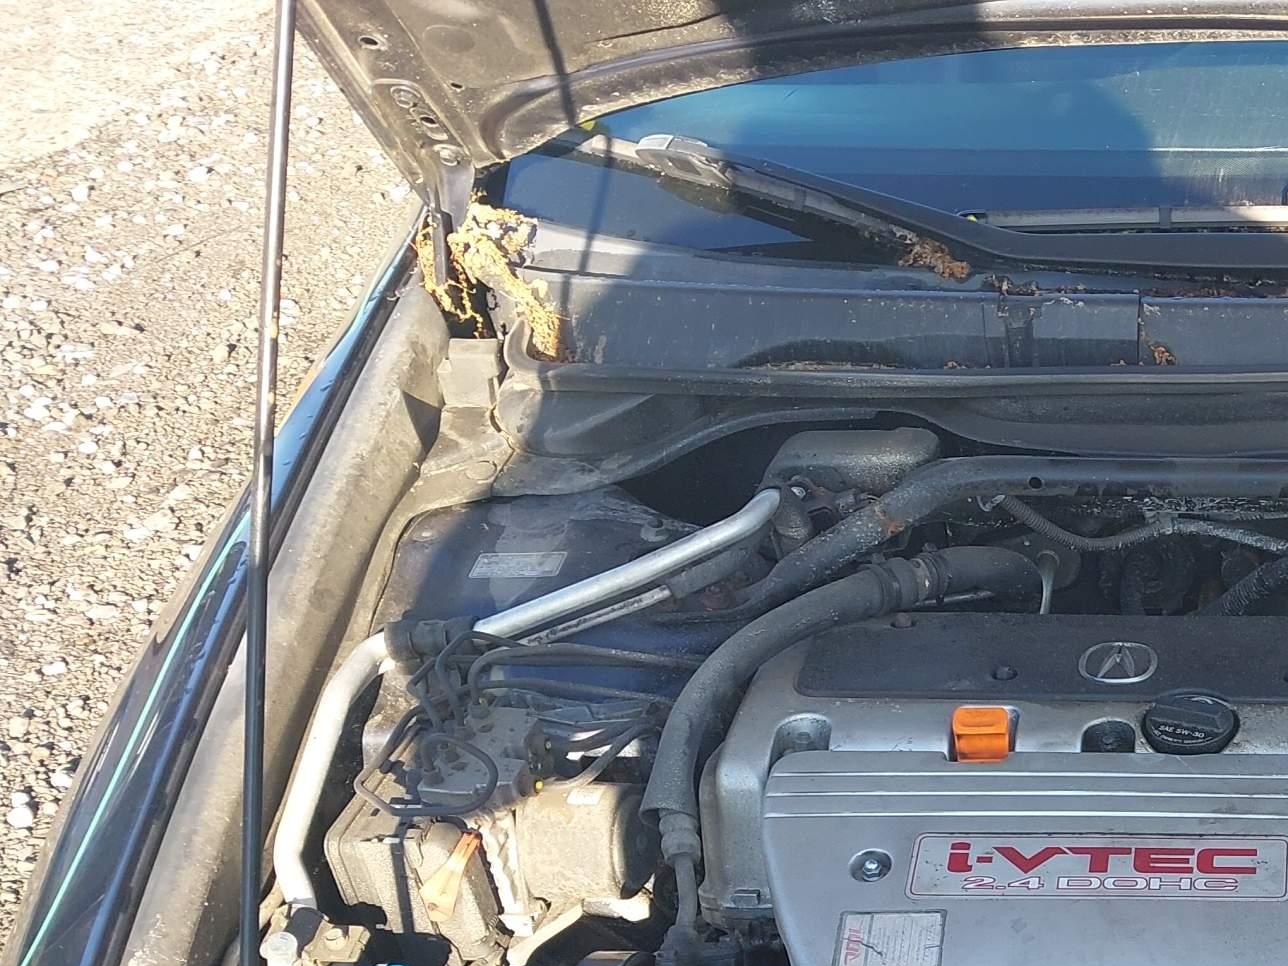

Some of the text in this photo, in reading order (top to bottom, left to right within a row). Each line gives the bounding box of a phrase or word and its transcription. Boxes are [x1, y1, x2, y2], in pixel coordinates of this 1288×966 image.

[1158, 725, 1174, 733] SAE
[946, 842, 1258, 875] i-VTEC
[961, 876, 1239, 892] 2.4 DOHC
